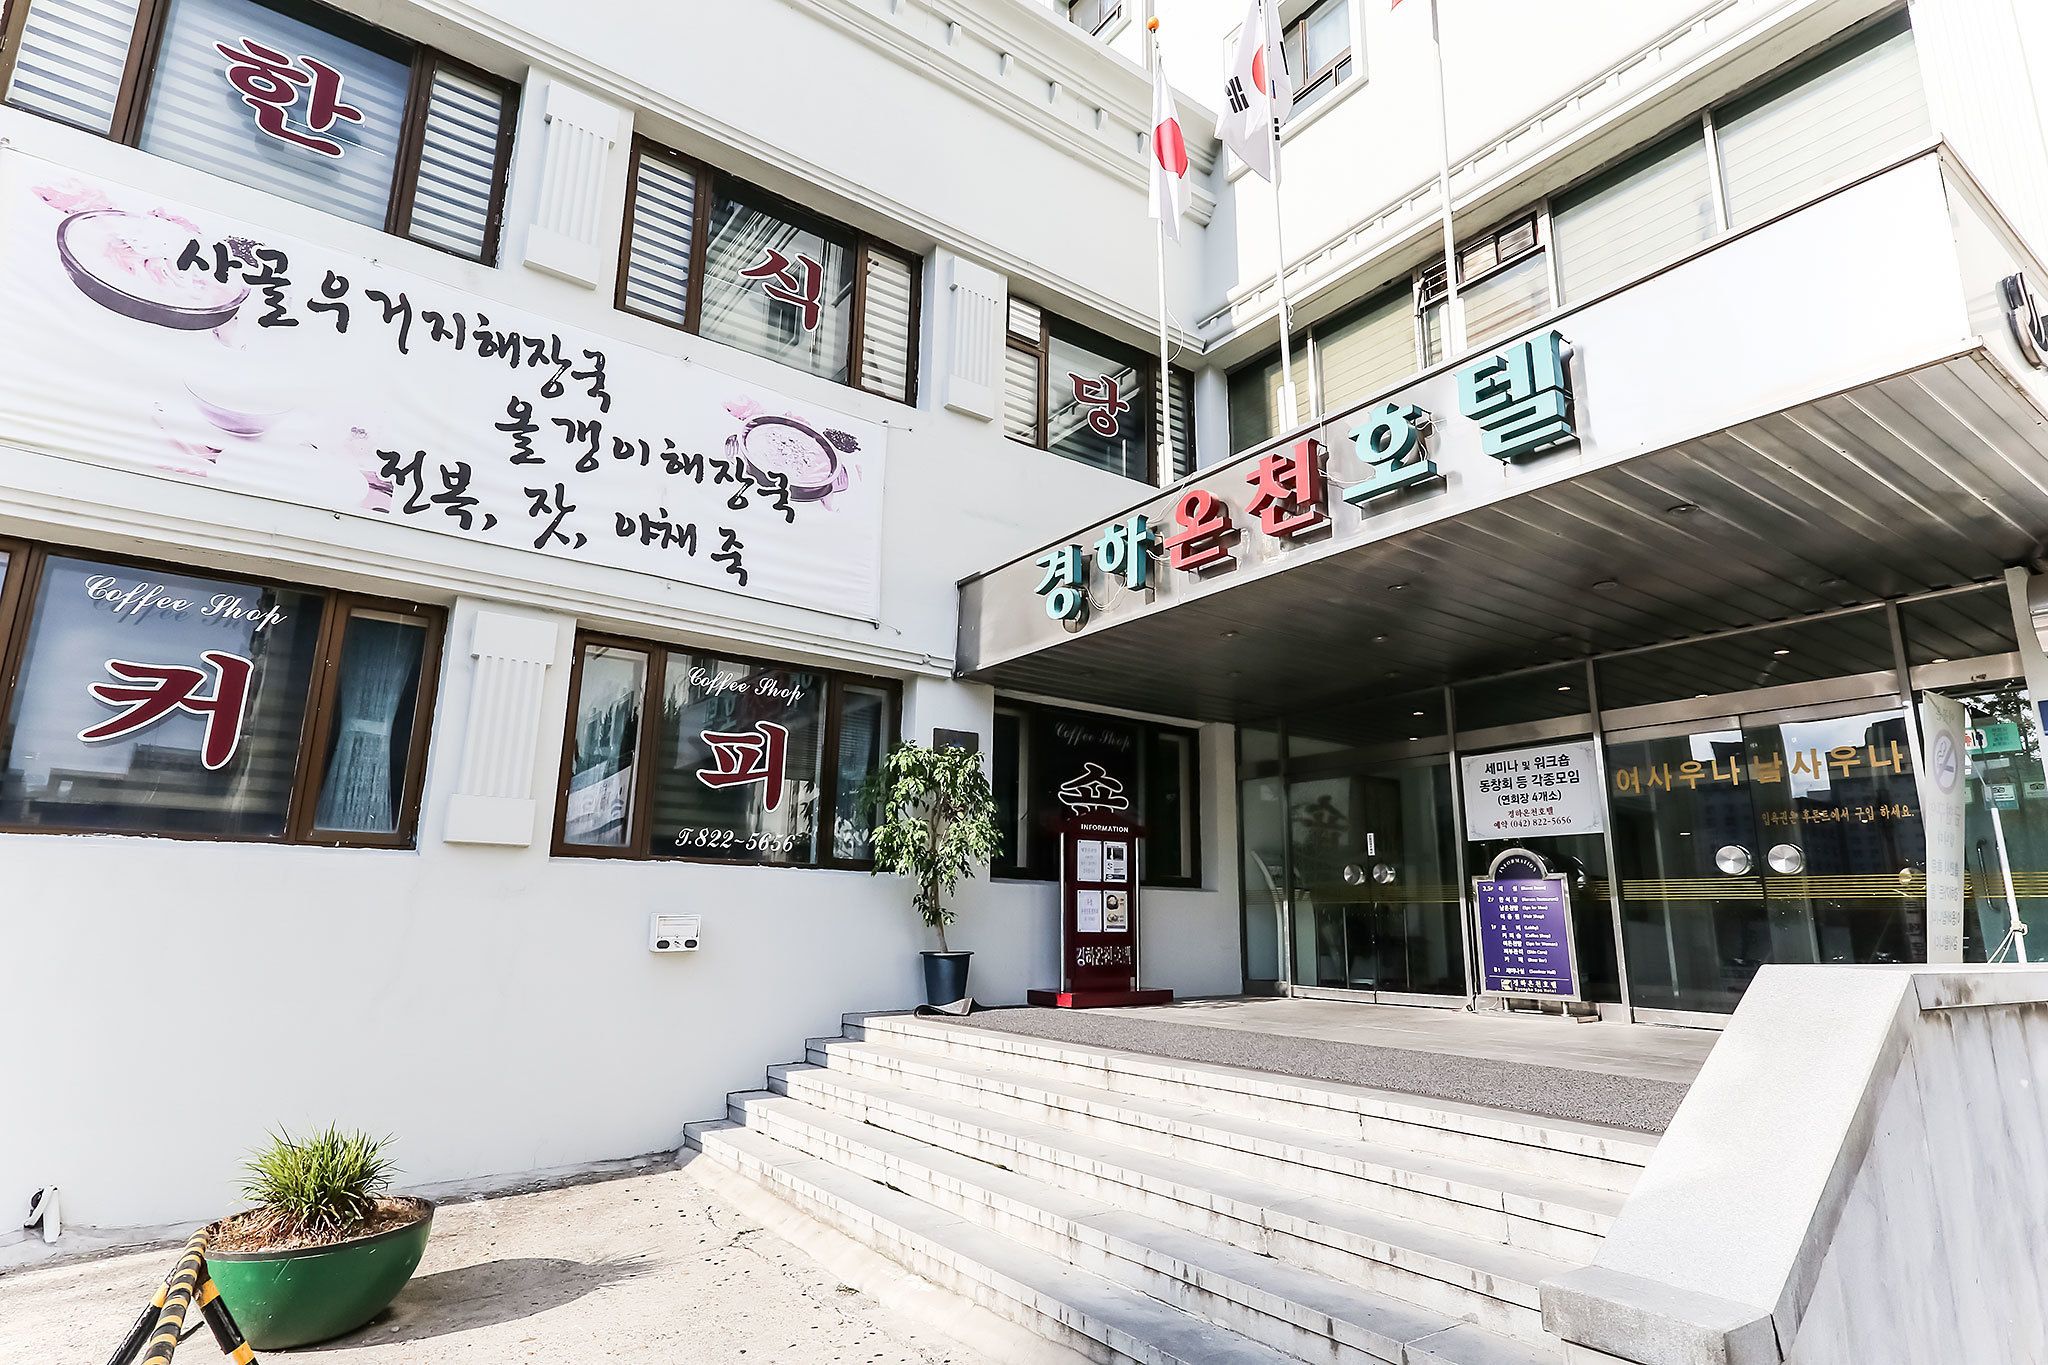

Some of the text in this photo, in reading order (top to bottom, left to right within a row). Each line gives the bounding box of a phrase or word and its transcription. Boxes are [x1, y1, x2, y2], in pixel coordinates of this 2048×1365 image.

[212, 35, 1131, 438] 한 식 당
[494, 395, 797, 524] 올갱이해장국
[84, 574, 288, 632] Coffee Shop
[688, 666, 806, 706] Coffee Shop
[76, 649, 255, 772] 커
[695, 720, 790, 814] 피
[1054, 721, 1132, 752] Coffee Shop
[1484, 753, 1570, 775] 세미나 및 워크숍
[1616, 755, 1741, 794] 여사우나
[1480, 770, 1580, 793] 동창회 등 각종모임
[1497, 790, 1562, 807] (연회장 4개소)
[1855, 806, 1875, 821] 구입
[1880, 803, 1915, 820] 하세요.
[1493, 816, 1572, 829] 예약 (042) 822-5656
[1508, 806, 1554, 819] 경하온천호텔
[1080, 822, 1129, 834] INFORMATION
